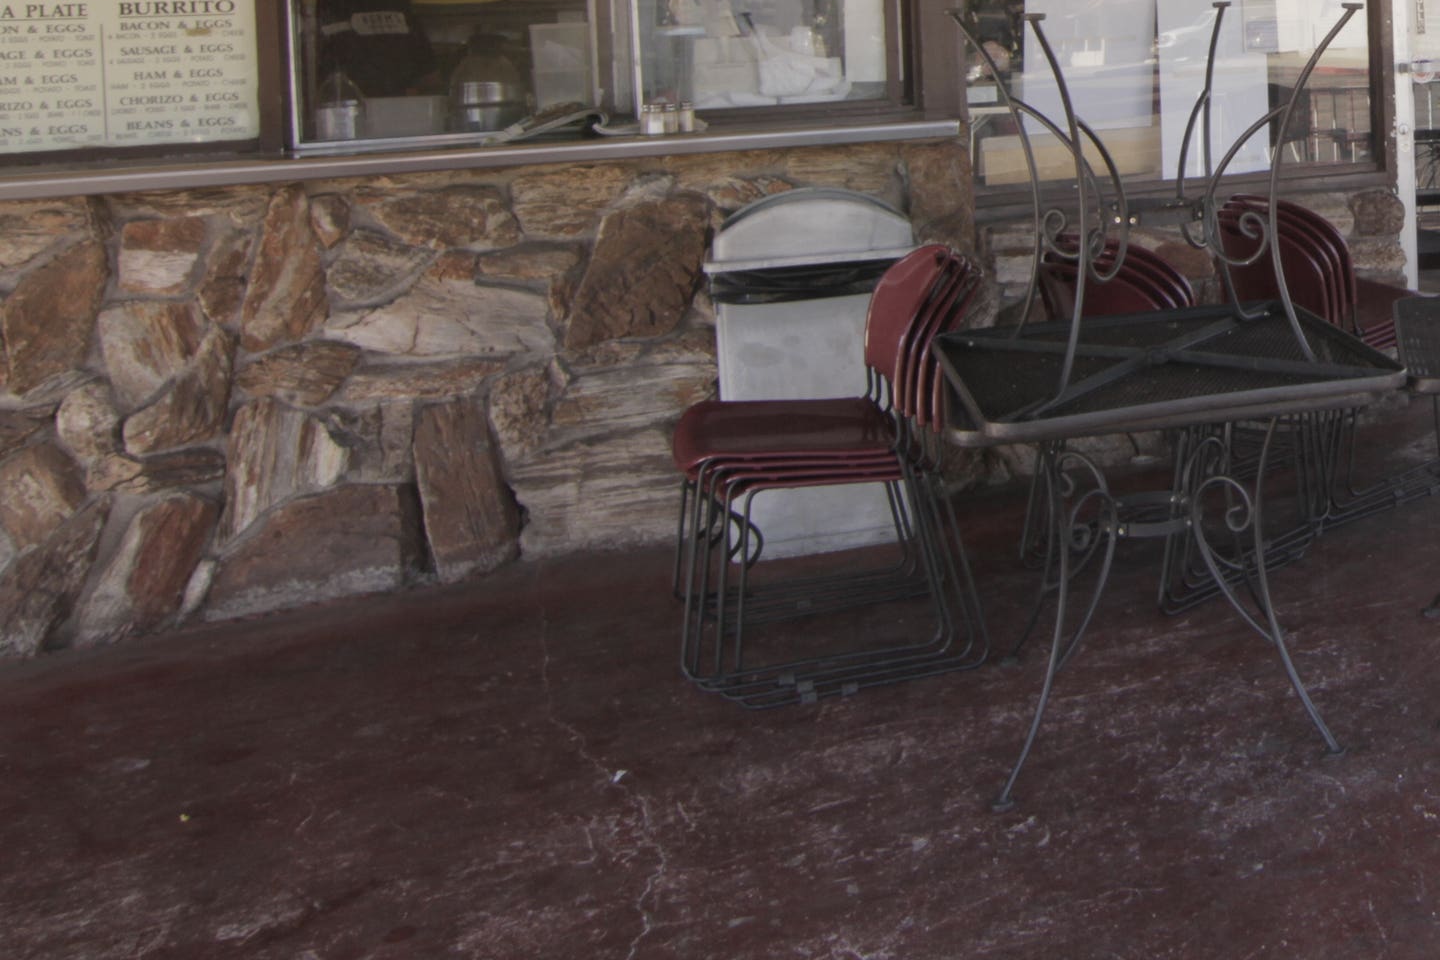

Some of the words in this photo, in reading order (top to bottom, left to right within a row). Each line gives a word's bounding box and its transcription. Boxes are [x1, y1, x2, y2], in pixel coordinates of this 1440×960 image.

[2, 6, 15, 18] A
[26, 3, 88, 17] PLATE
[119, 0, 235, 15] BURRITO
[27, 25, 38, 34] &
[46, 24, 85, 33] EGGS
[120, 21, 170, 31] BACON
[178, 21, 190, 29] &
[195, 19, 232, 29] EGGS
[35, 50, 45, 58] &
[54, 49, 93, 58] EGGS
[120, 46, 176, 56] SAUSAGE
[184, 45, 193, 53] &
[200, 44, 234, 53] EGGS
[42, 75, 78, 84] EGGS
[134, 71, 167, 80] HAM
[173, 71, 183, 79] &
[190, 69, 223, 78] EGGS
[40, 101, 49, 110] &
[57, 99, 92, 108] EGGS
[120, 95, 183, 105] CHORIZO
[191, 94, 200, 102] &
[205, 93, 239, 102] EGGS
[127, 120, 174, 130] BEANS
[181, 119, 190, 128] &
[198, 118, 236, 126] EGGS
[30, 127, 39, 135] &
[48, 125, 88, 134] EGGS
